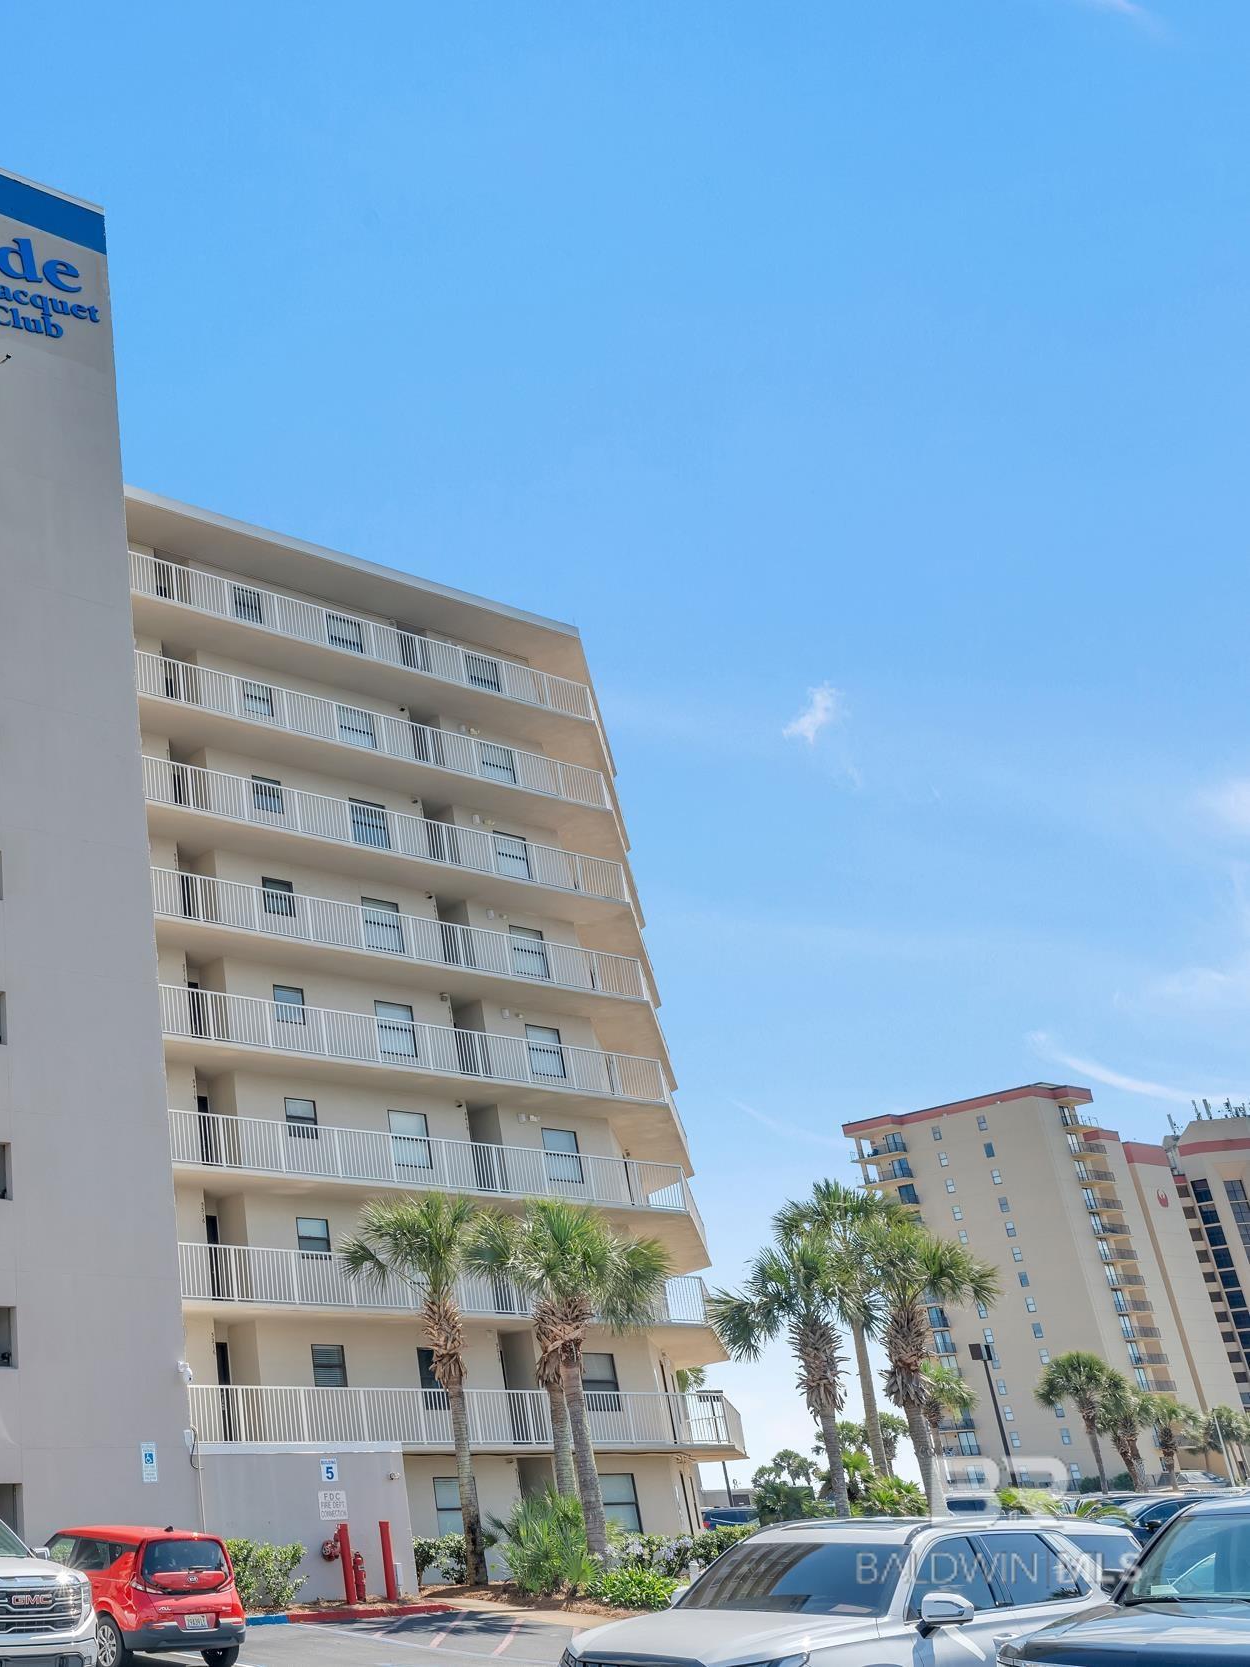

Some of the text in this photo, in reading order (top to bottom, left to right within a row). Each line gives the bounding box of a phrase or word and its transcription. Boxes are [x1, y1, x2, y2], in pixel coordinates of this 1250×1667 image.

[326, 1466, 334, 1480] 5
[320, 1501, 332, 1509] FIRE
[11, 1594, 53, 1606] GMC
